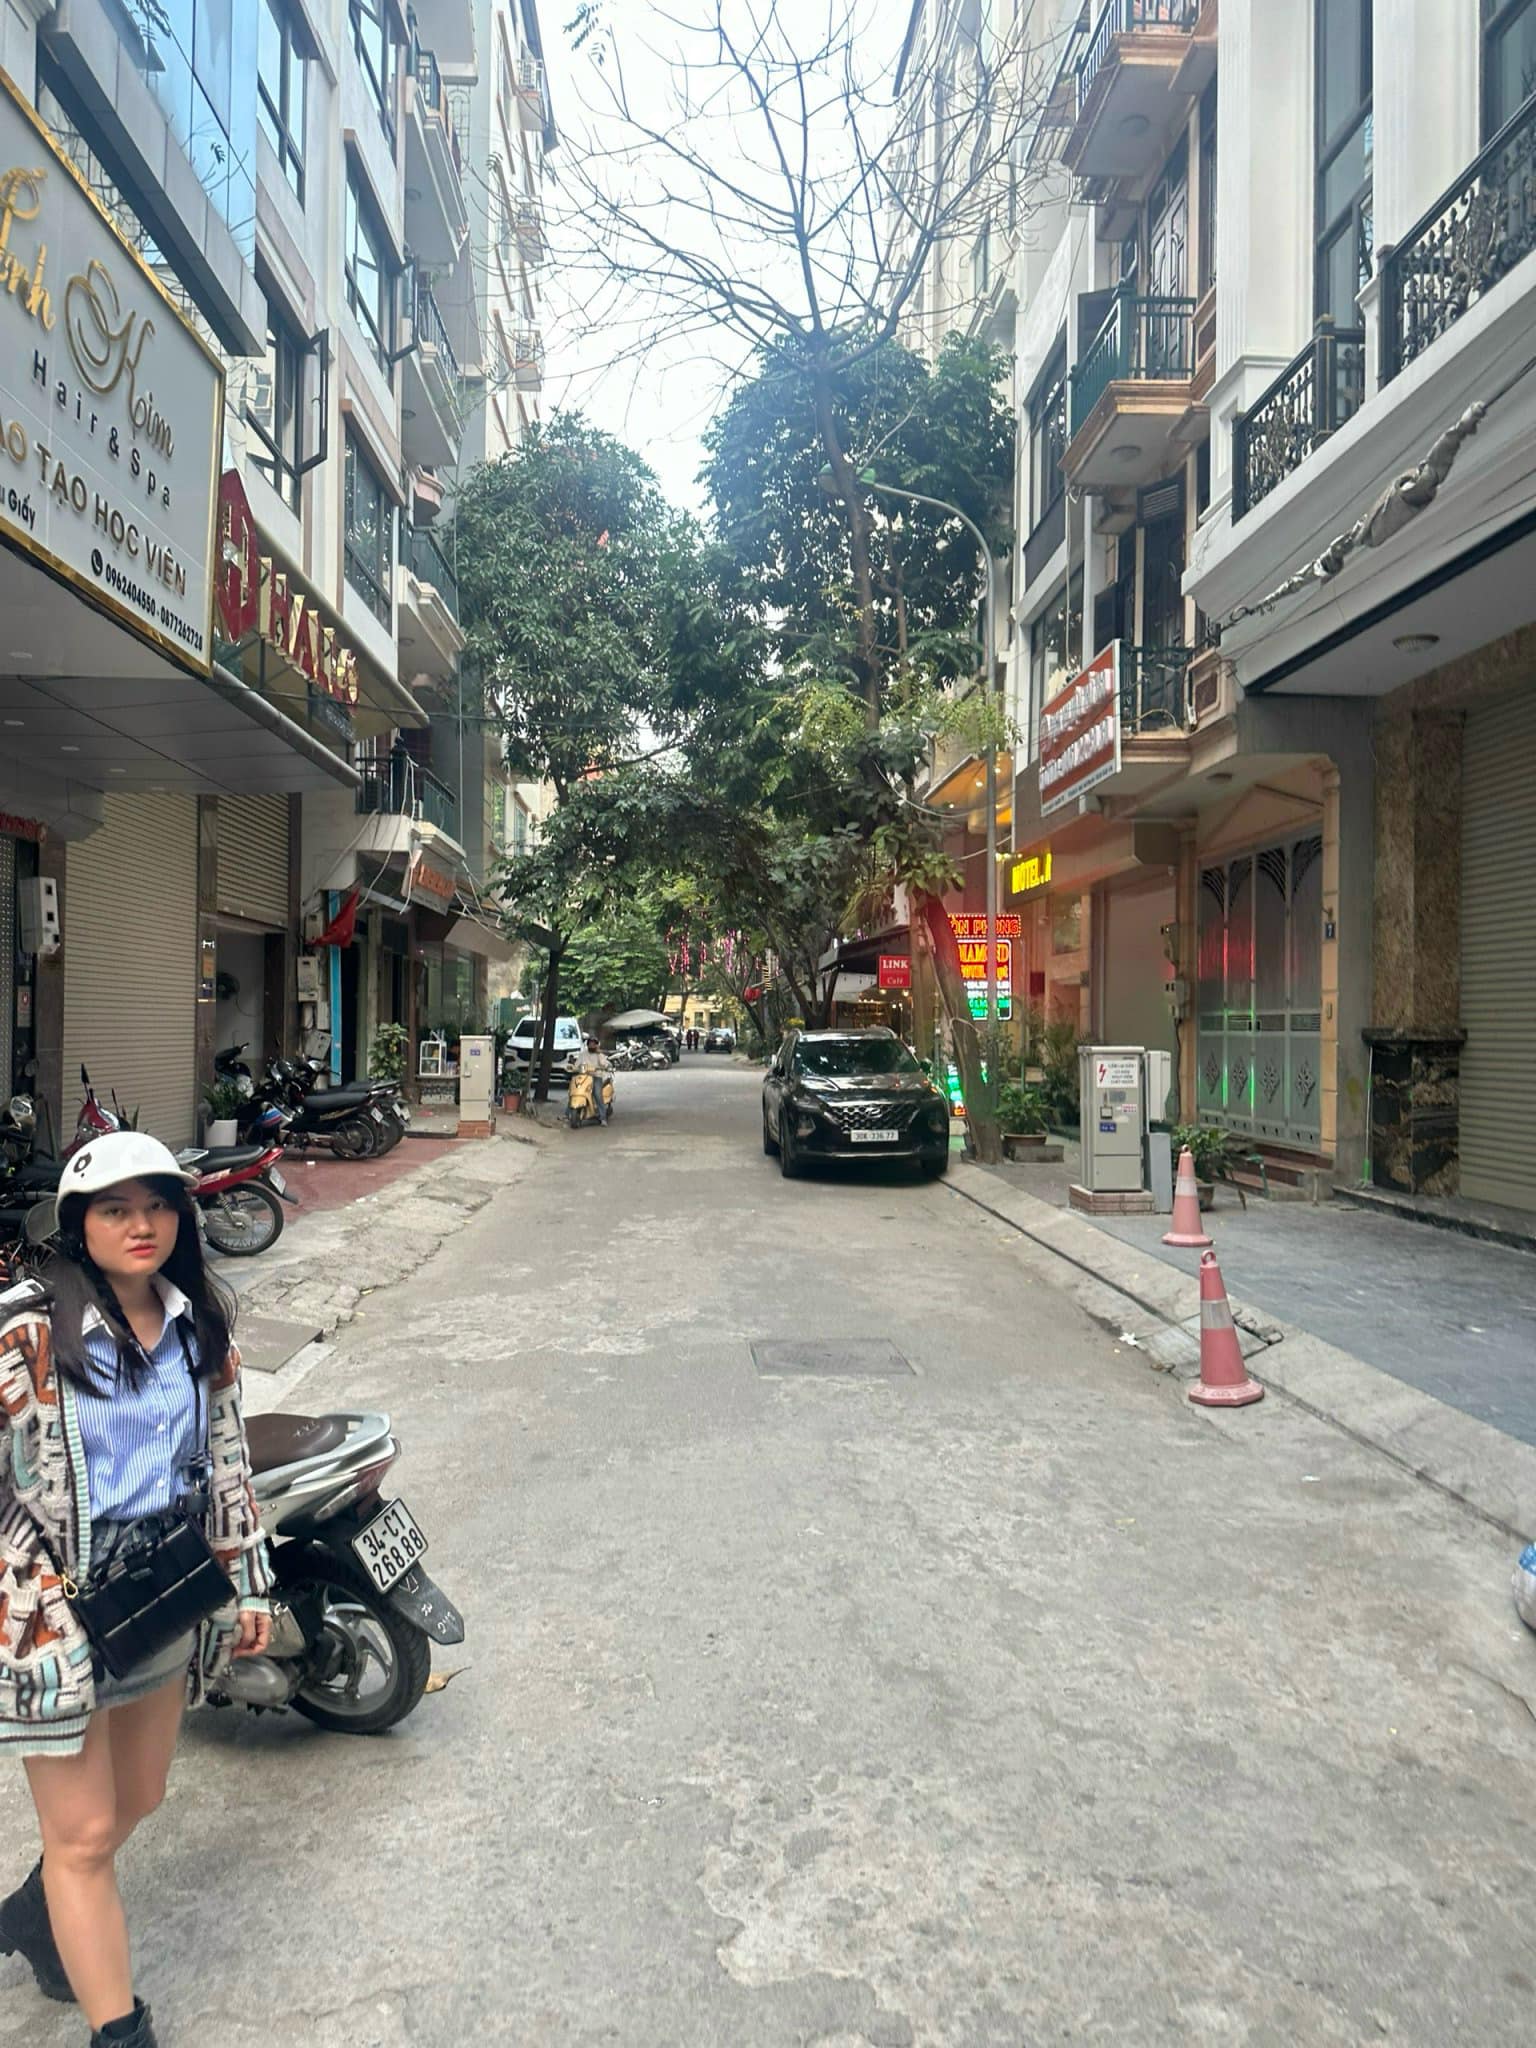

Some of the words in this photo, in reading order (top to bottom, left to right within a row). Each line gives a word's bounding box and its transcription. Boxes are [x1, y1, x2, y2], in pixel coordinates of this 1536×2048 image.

[33, 349, 98, 434] Hair
[109, 426, 119, 458] &
[130, 447, 171, 507] Spa
[8, 487, 36, 531] Giấy
[36, 442, 88, 512] TẠO
[94, 491, 141, 557] HỌC
[145, 535, 187, 597] VIÊN
[883, 959, 909, 969] LINK
[362, 1508, 406, 1558] 34-C1
[372, 1527, 424, 1587] 268.88
